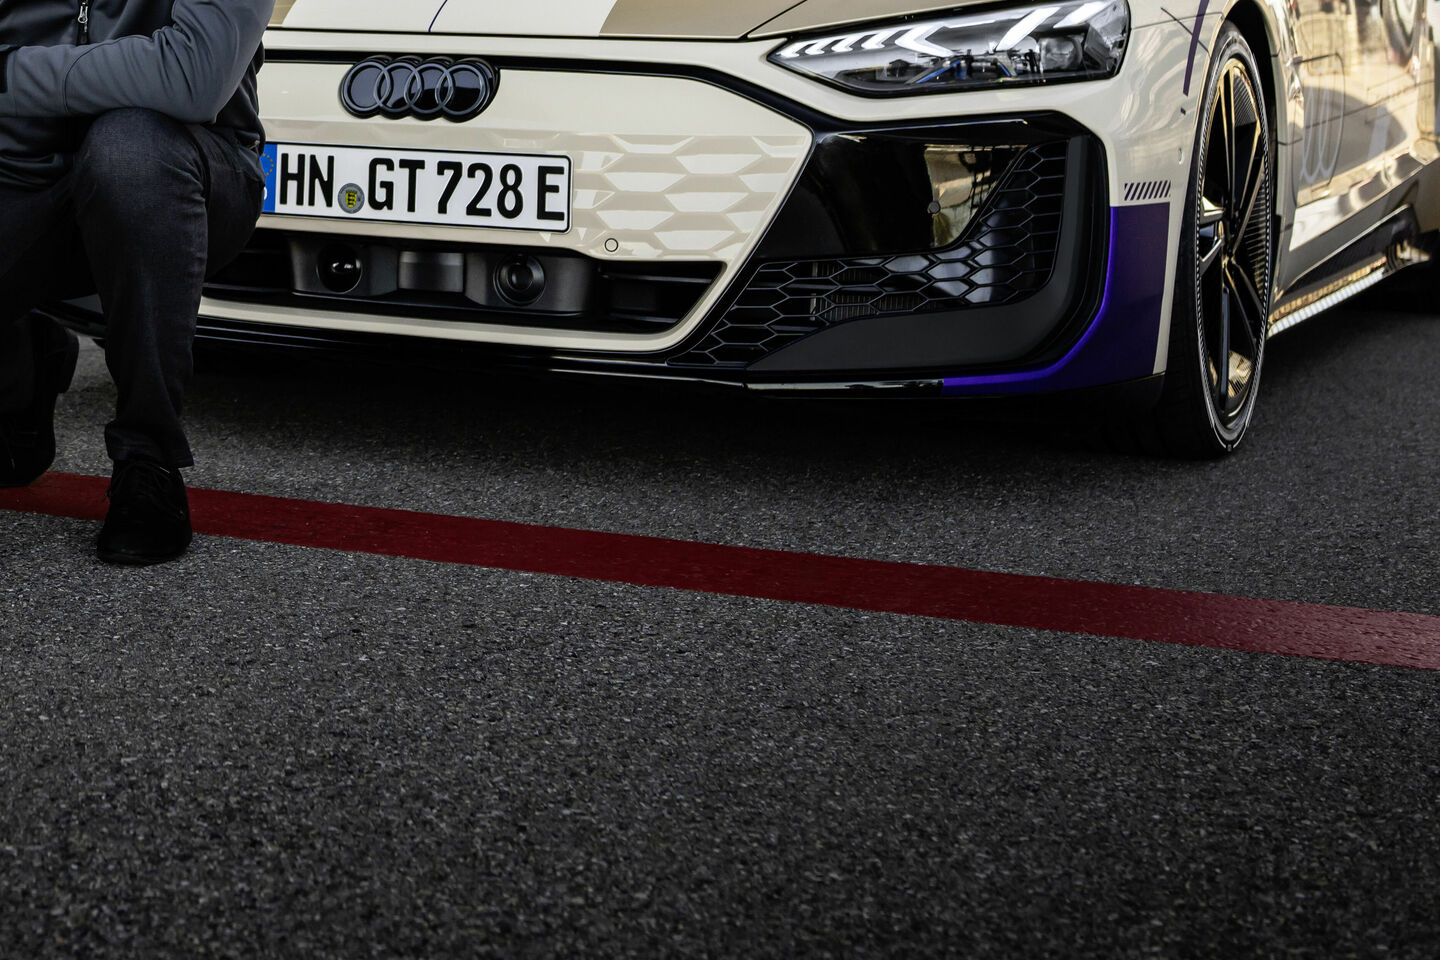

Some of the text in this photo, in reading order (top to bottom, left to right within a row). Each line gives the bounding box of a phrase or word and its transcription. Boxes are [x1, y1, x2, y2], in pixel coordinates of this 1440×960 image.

[279, 152, 565, 221] HN GT 728 E
